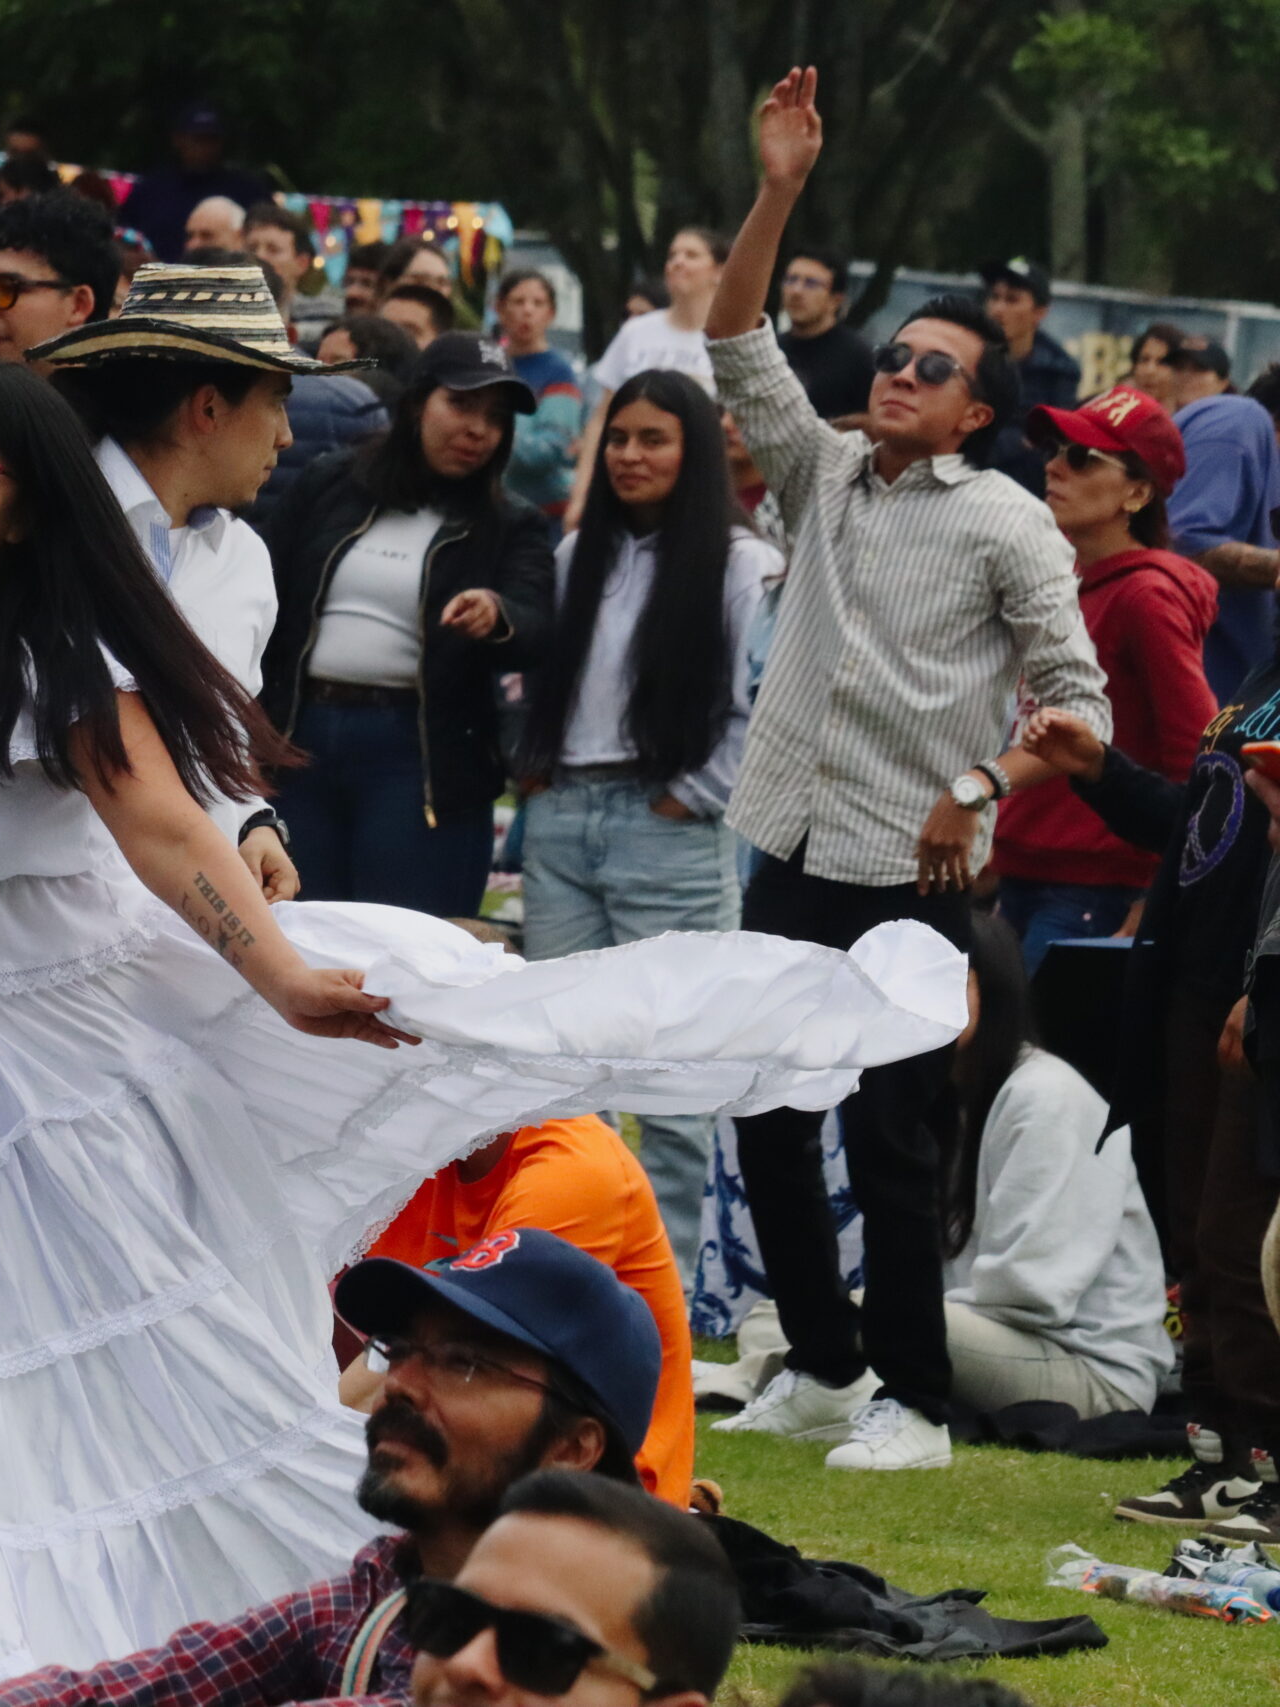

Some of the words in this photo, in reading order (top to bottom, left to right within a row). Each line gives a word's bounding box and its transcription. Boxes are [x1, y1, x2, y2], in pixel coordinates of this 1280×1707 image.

[193, 871, 227, 914] THIS
[223, 911, 241, 931] IS
[237, 927, 257, 948] IT
[449, 1229, 521, 1272] B
